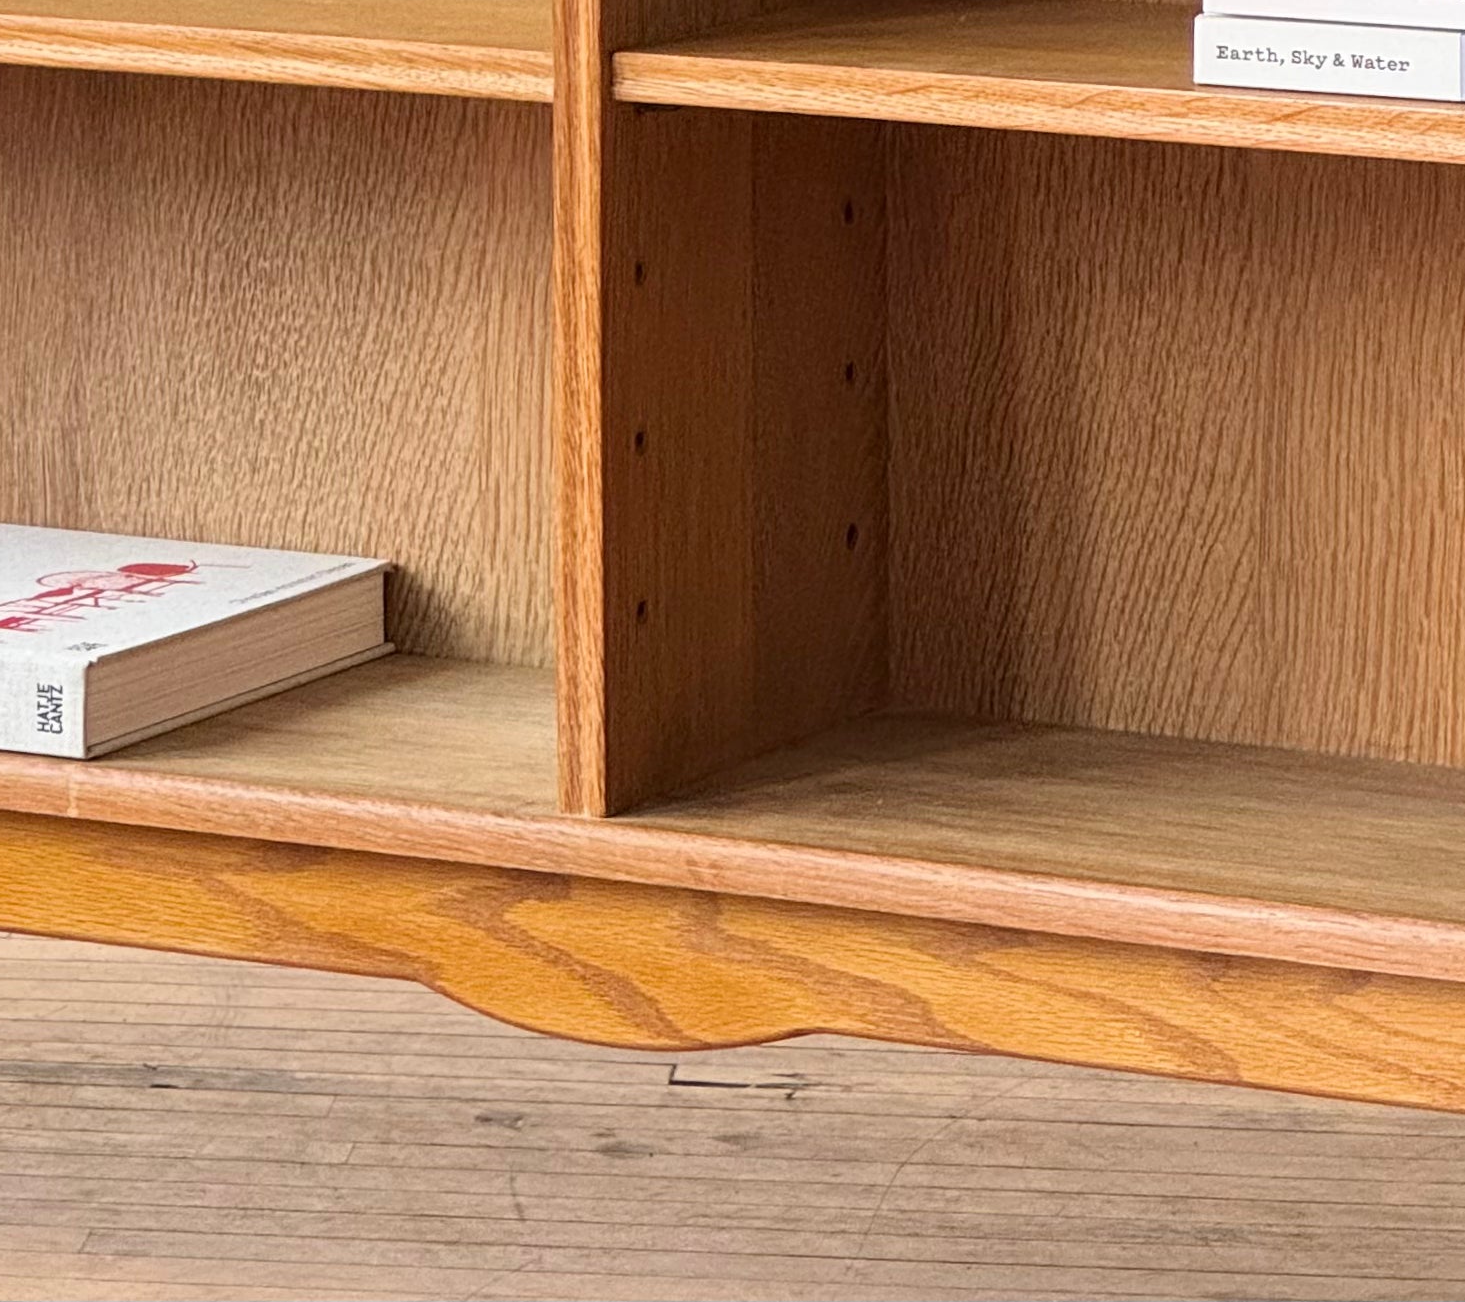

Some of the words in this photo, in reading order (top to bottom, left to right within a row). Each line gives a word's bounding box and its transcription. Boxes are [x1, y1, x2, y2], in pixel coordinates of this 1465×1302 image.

[1215, 45, 1285, 67] Earth,
[1290, 49, 1328, 70] Sky
[1332, 52, 1346, 68] &
[1350, 53, 1410, 72] Water
[36, 682, 50, 733] HATJE
[49, 683, 64, 735] CANTZ
